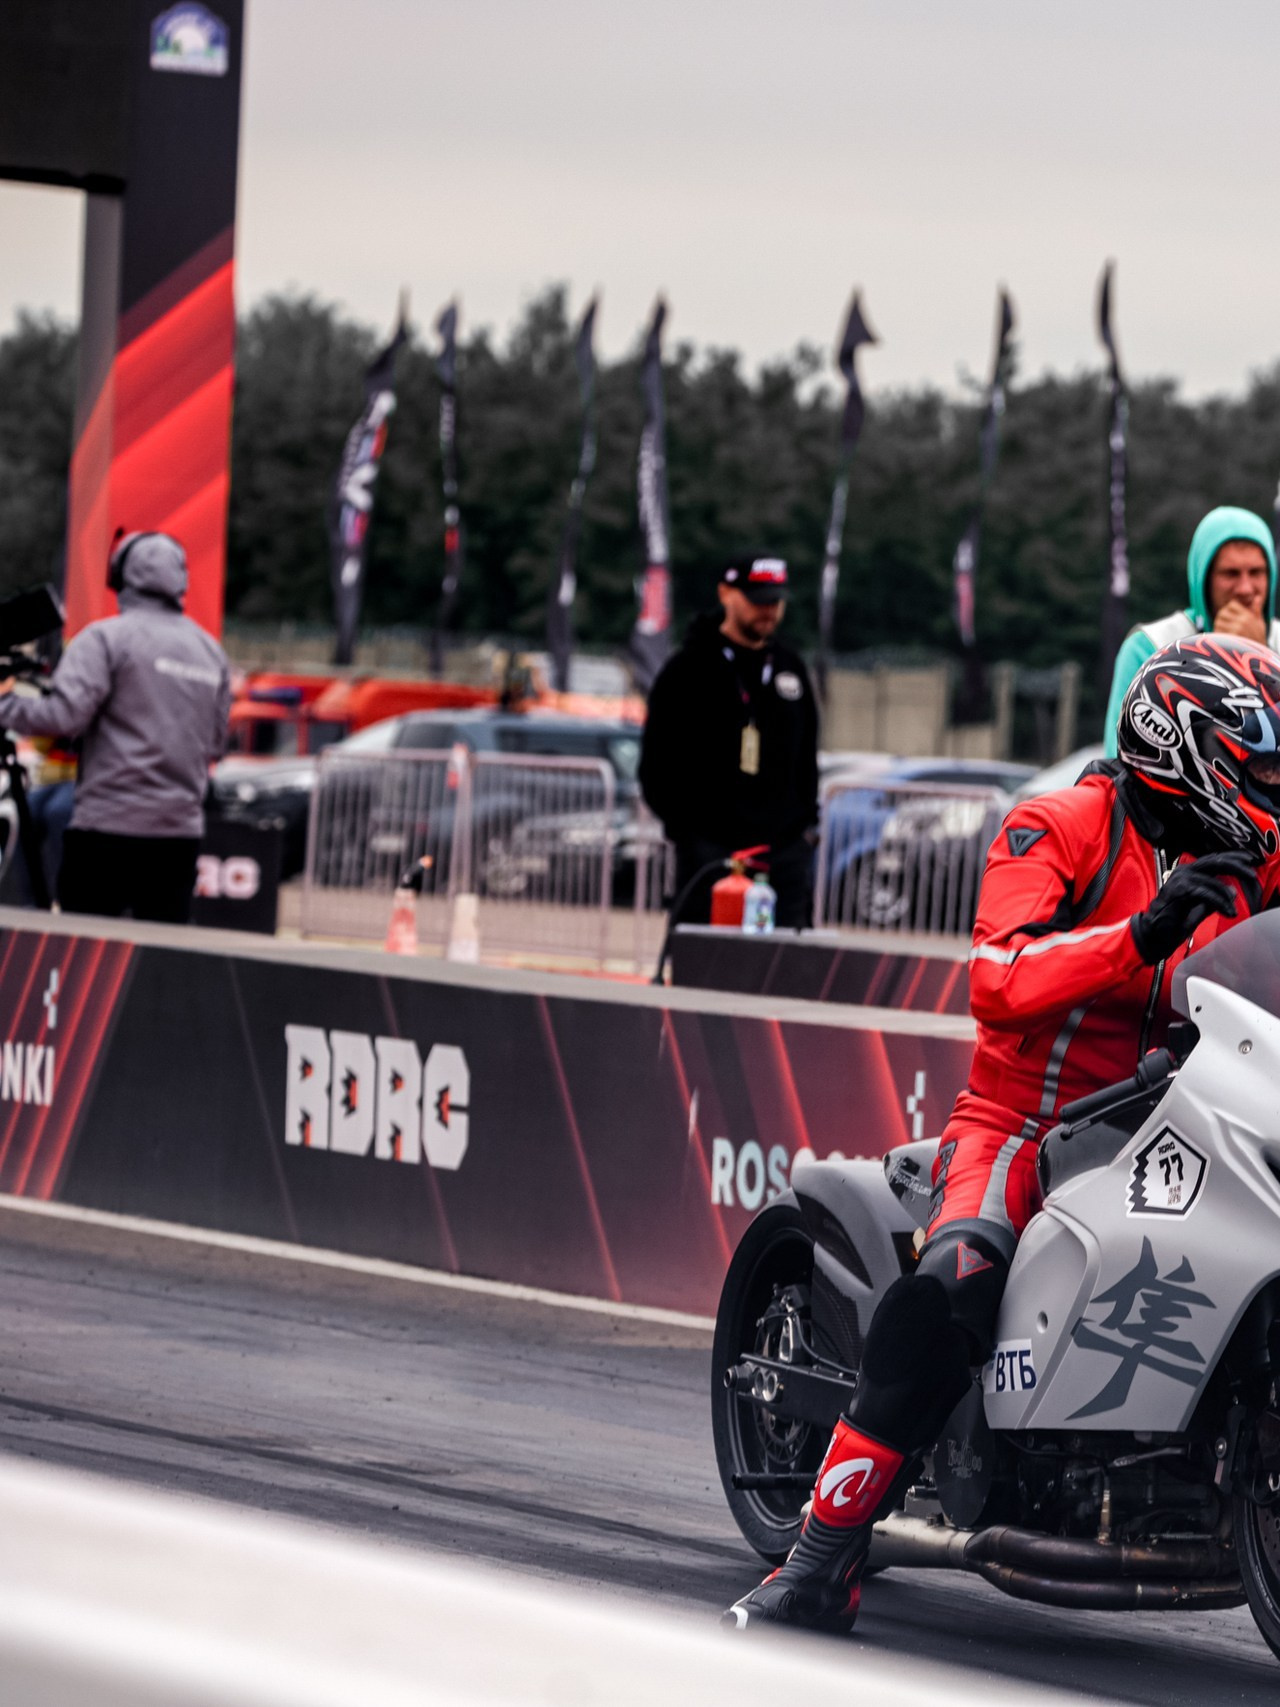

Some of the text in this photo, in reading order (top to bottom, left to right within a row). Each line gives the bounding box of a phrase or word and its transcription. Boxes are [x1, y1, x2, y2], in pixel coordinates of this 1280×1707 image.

[1133, 709, 1177, 741] Arai
[0, 1041, 55, 1107] NKI
[285, 1024, 470, 1170] RDRC
[1159, 1152, 1184, 1187] 77
[996, 1350, 1036, 1392] ВТБ
